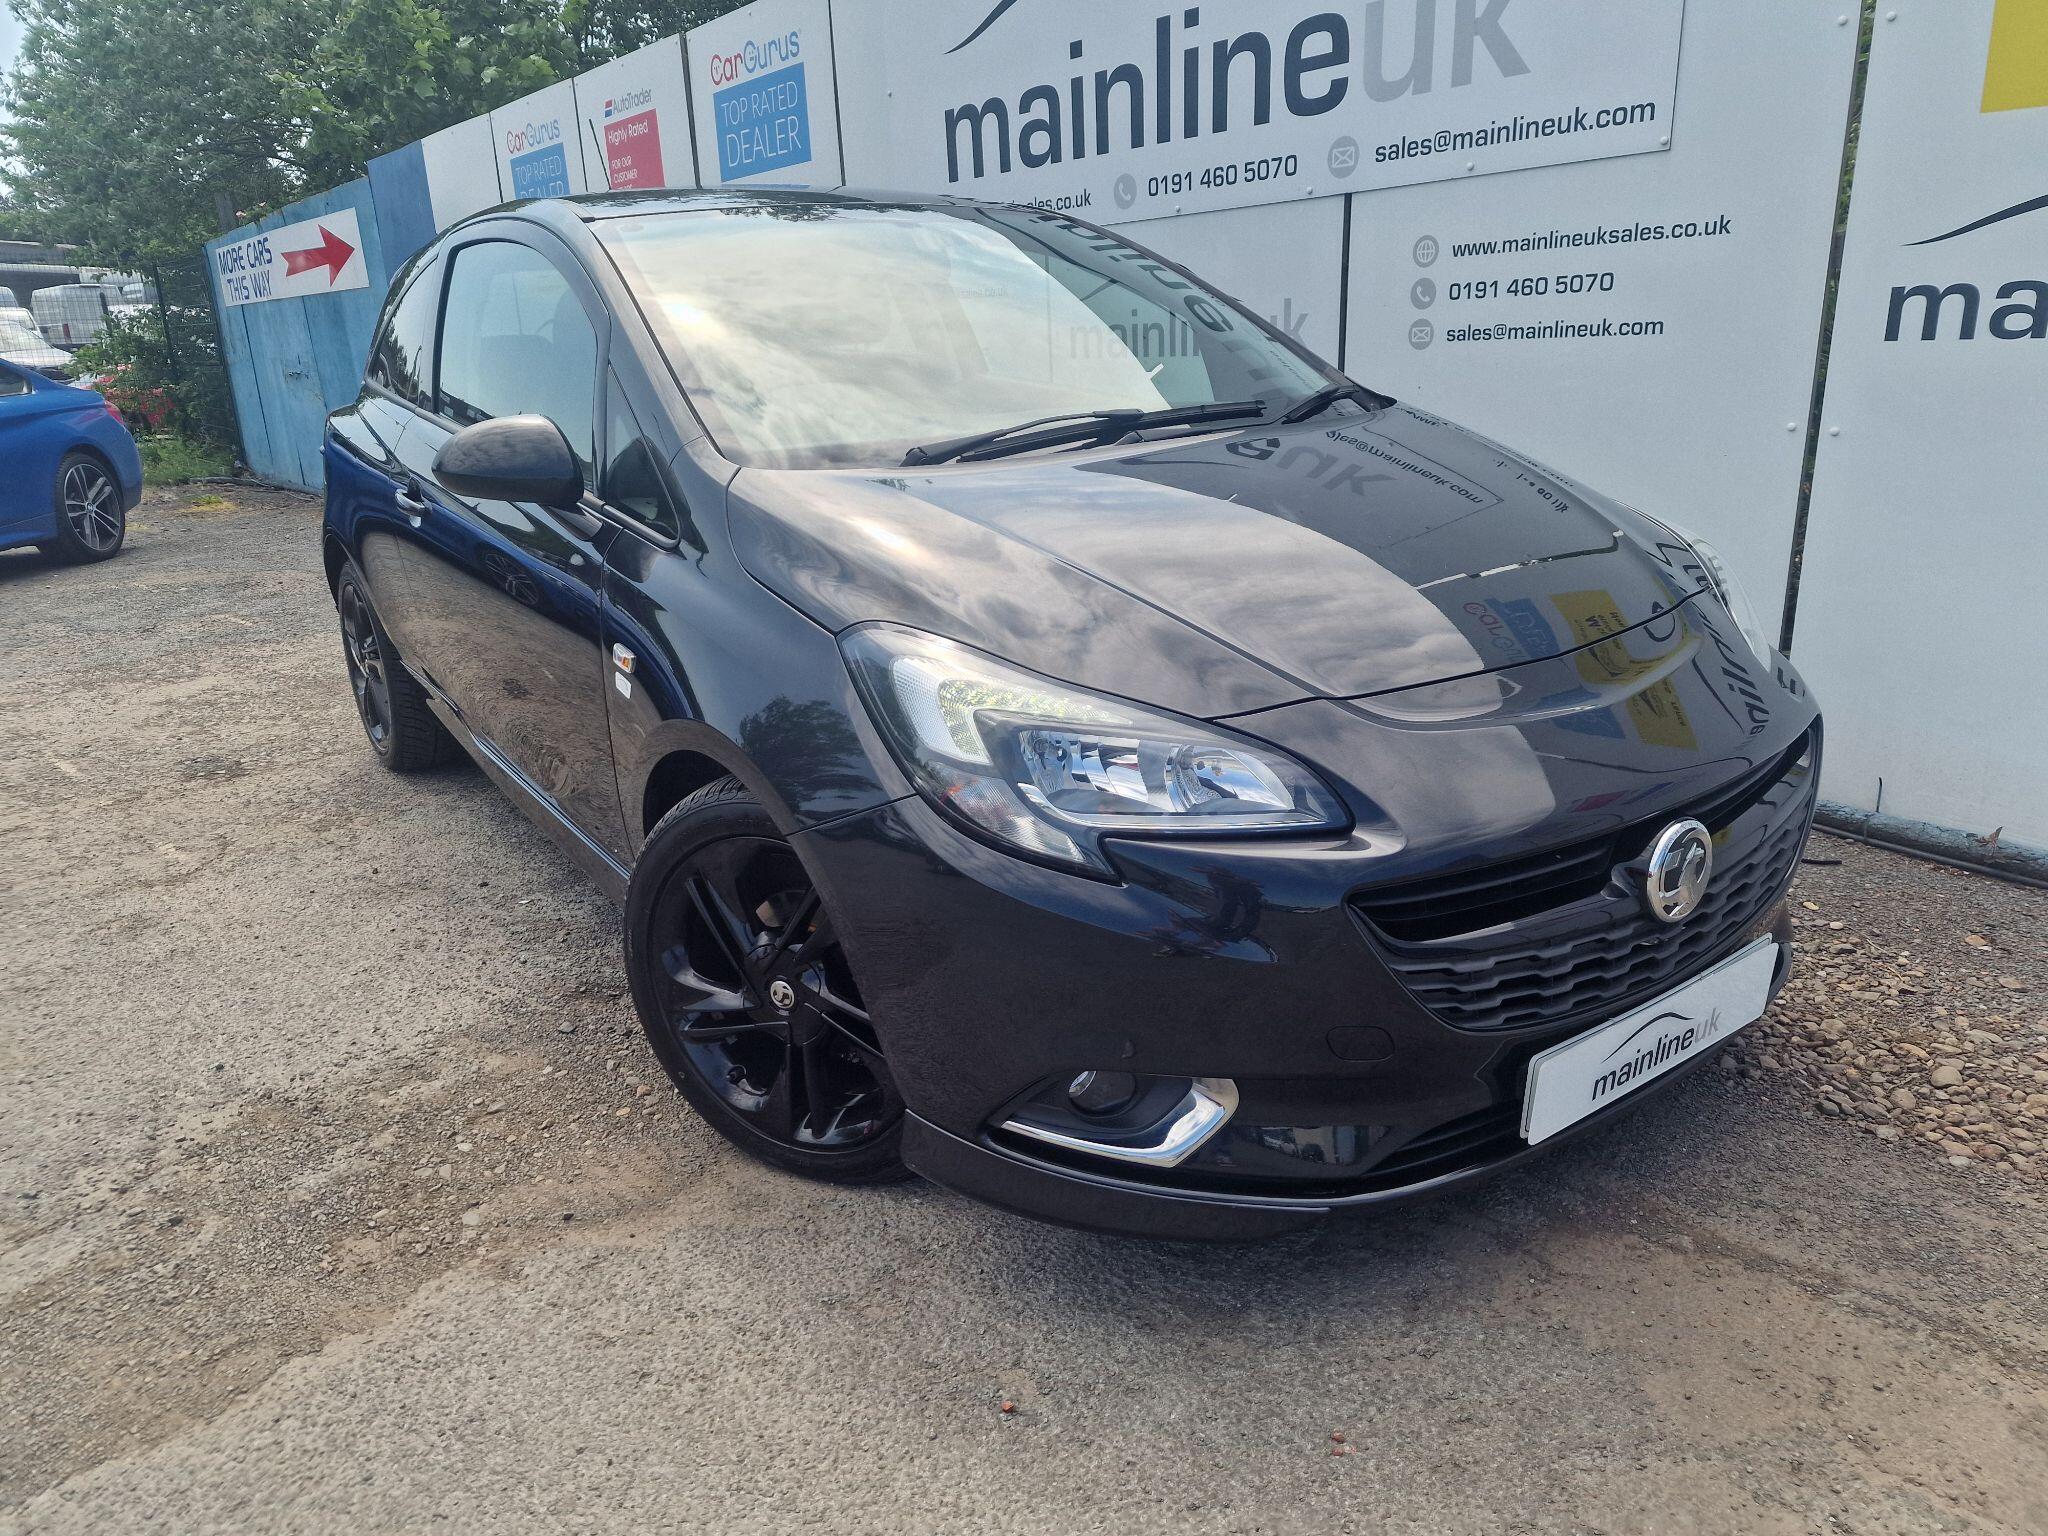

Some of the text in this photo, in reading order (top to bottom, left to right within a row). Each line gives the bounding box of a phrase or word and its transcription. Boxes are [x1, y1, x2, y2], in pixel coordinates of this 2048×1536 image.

[711, 31, 800, 85] CarGurus
[613, 89, 652, 114] AutoTrader
[721, 81, 798, 127] TOP RATED
[944, 0, 1531, 183] mainlineuk
[506, 118, 560, 153] CarGurus
[608, 120, 649, 146] Highly Rated
[726, 116, 801, 167] DEALER
[1375, 101, 1656, 163] sales@mainlineuk.com
[515, 156, 562, 184] TOP RATED
[1148, 154, 1298, 197] 0191 460 5070
[218, 237, 273, 276] MORE CARS
[1452, 214, 1732, 258] www.mainlineuksales.co.uk
[226, 270, 272, 302] THIS WAY
[1449, 272, 1615, 301] 0191 460 5070
[1446, 318, 1664, 342] sales@mainlineuk.com
[1592, 1008, 1721, 1101] mainlineuk
